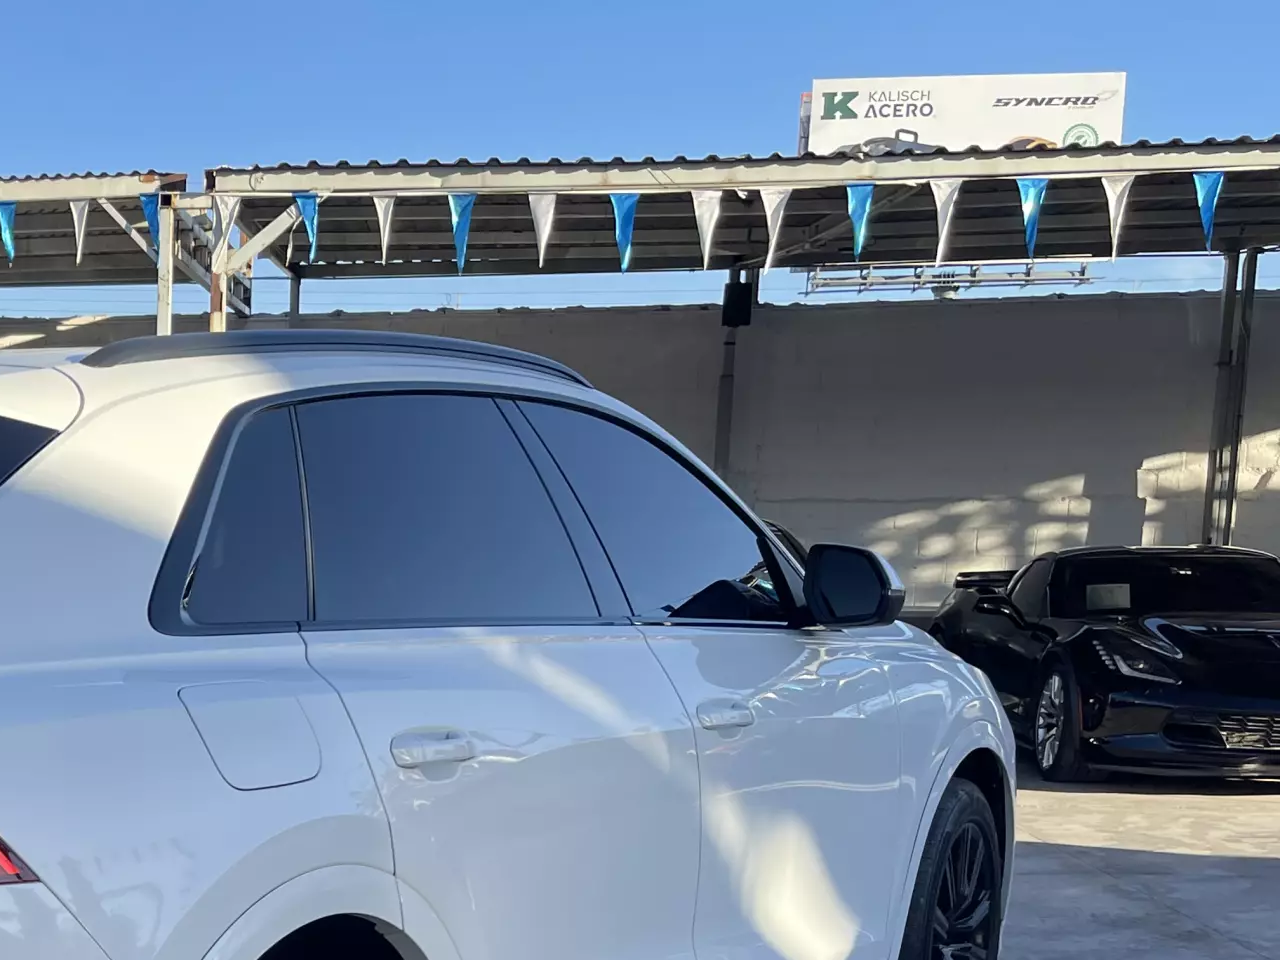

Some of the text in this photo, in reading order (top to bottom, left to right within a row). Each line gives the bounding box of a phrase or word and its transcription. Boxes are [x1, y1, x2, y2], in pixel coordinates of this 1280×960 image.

[868, 90, 931, 102] KALISCH
[992, 96, 1099, 107] SYNCRO
[820, 91, 859, 120] K
[864, 103, 933, 119] ACERO
